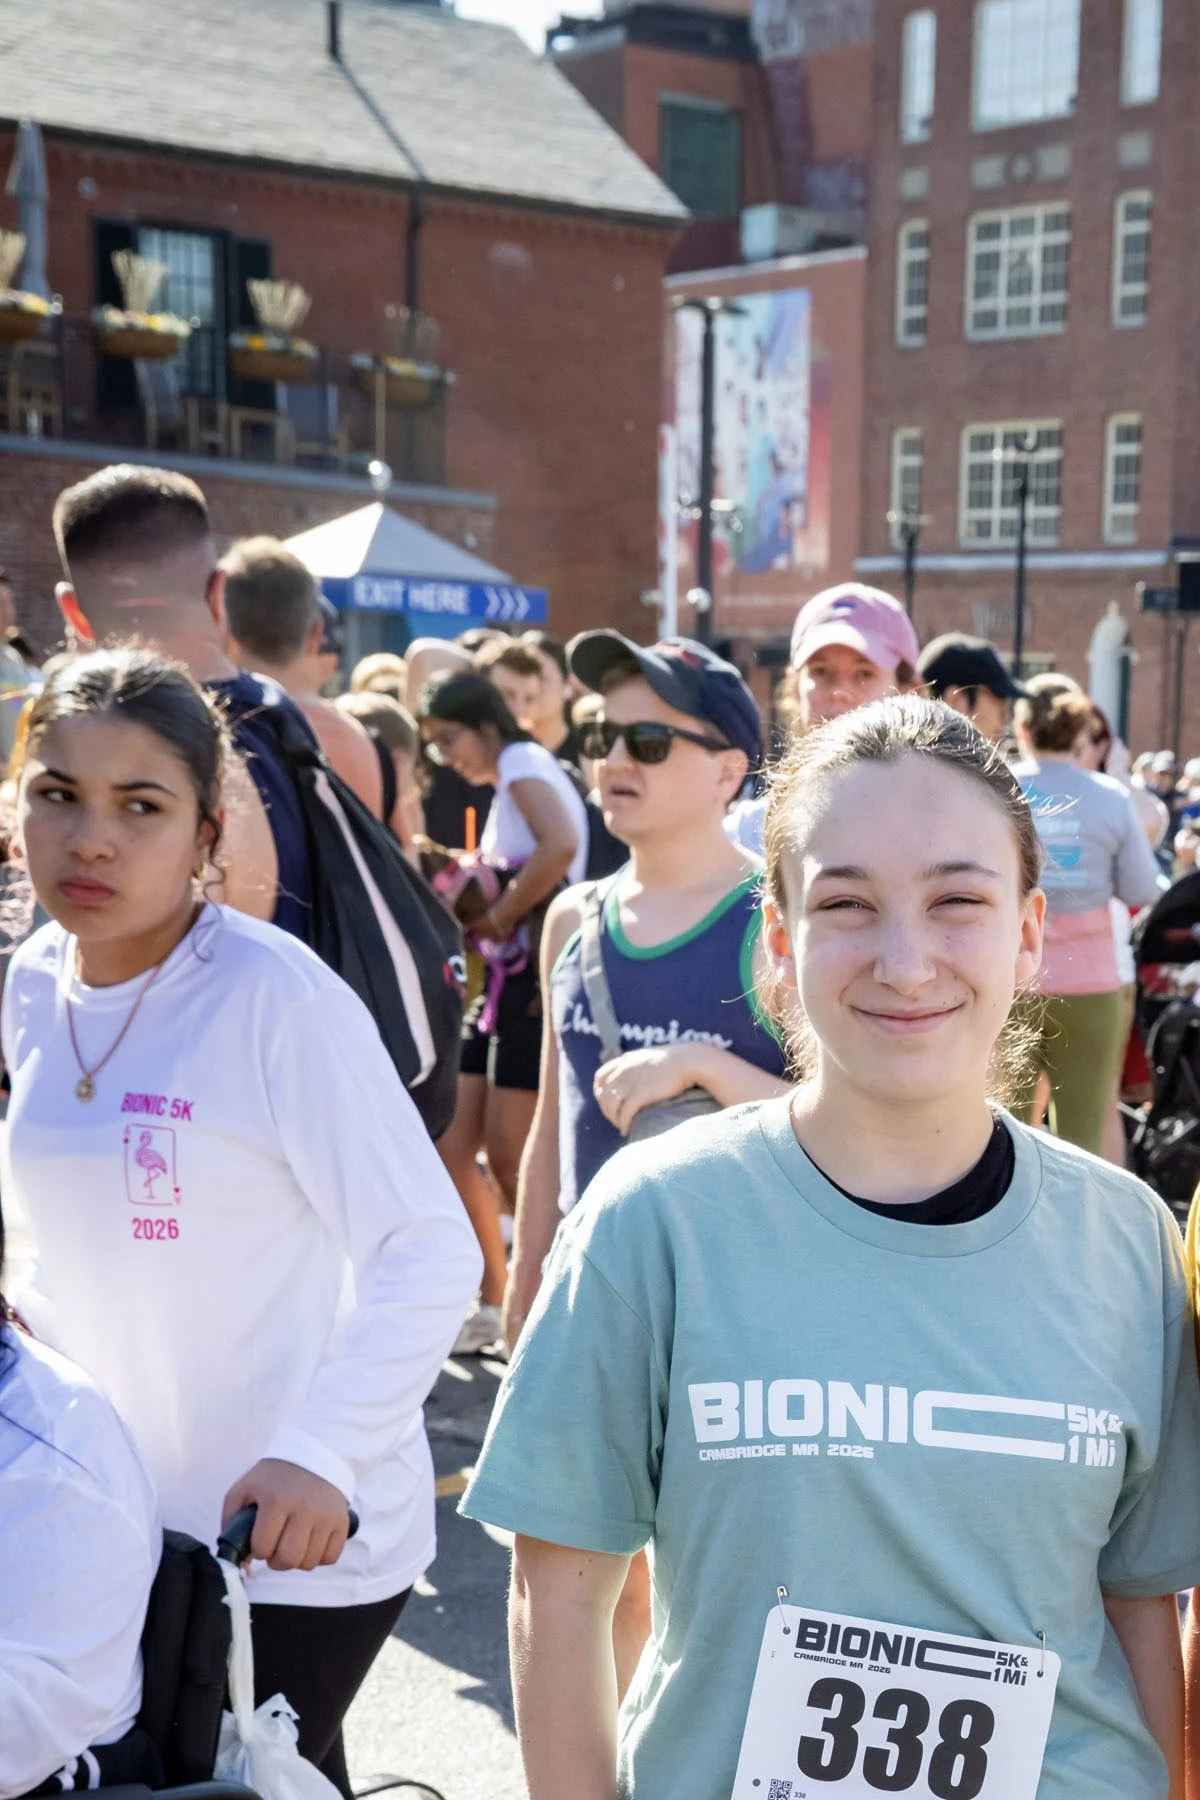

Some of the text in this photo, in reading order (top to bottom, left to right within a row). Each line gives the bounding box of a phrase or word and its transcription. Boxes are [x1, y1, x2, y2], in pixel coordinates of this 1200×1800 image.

[353, 578, 469, 615] EXIT HERE
[120, 1091, 195, 1121] BIONIC 5K
[132, 1217, 180, 1241] 2026
[688, 1378, 1066, 1461] BIONIC
[1067, 1404, 1123, 1436] 5K&
[699, 1443, 875, 1461] CAMBRIDGE MA 2026
[795, 1617, 997, 1681] BIONIC
[996, 1651, 1029, 1668] 5K&
[793, 1652, 891, 1674] CAMBRIDGE MA 2026
[794, 1791, 806, 1799] 338
